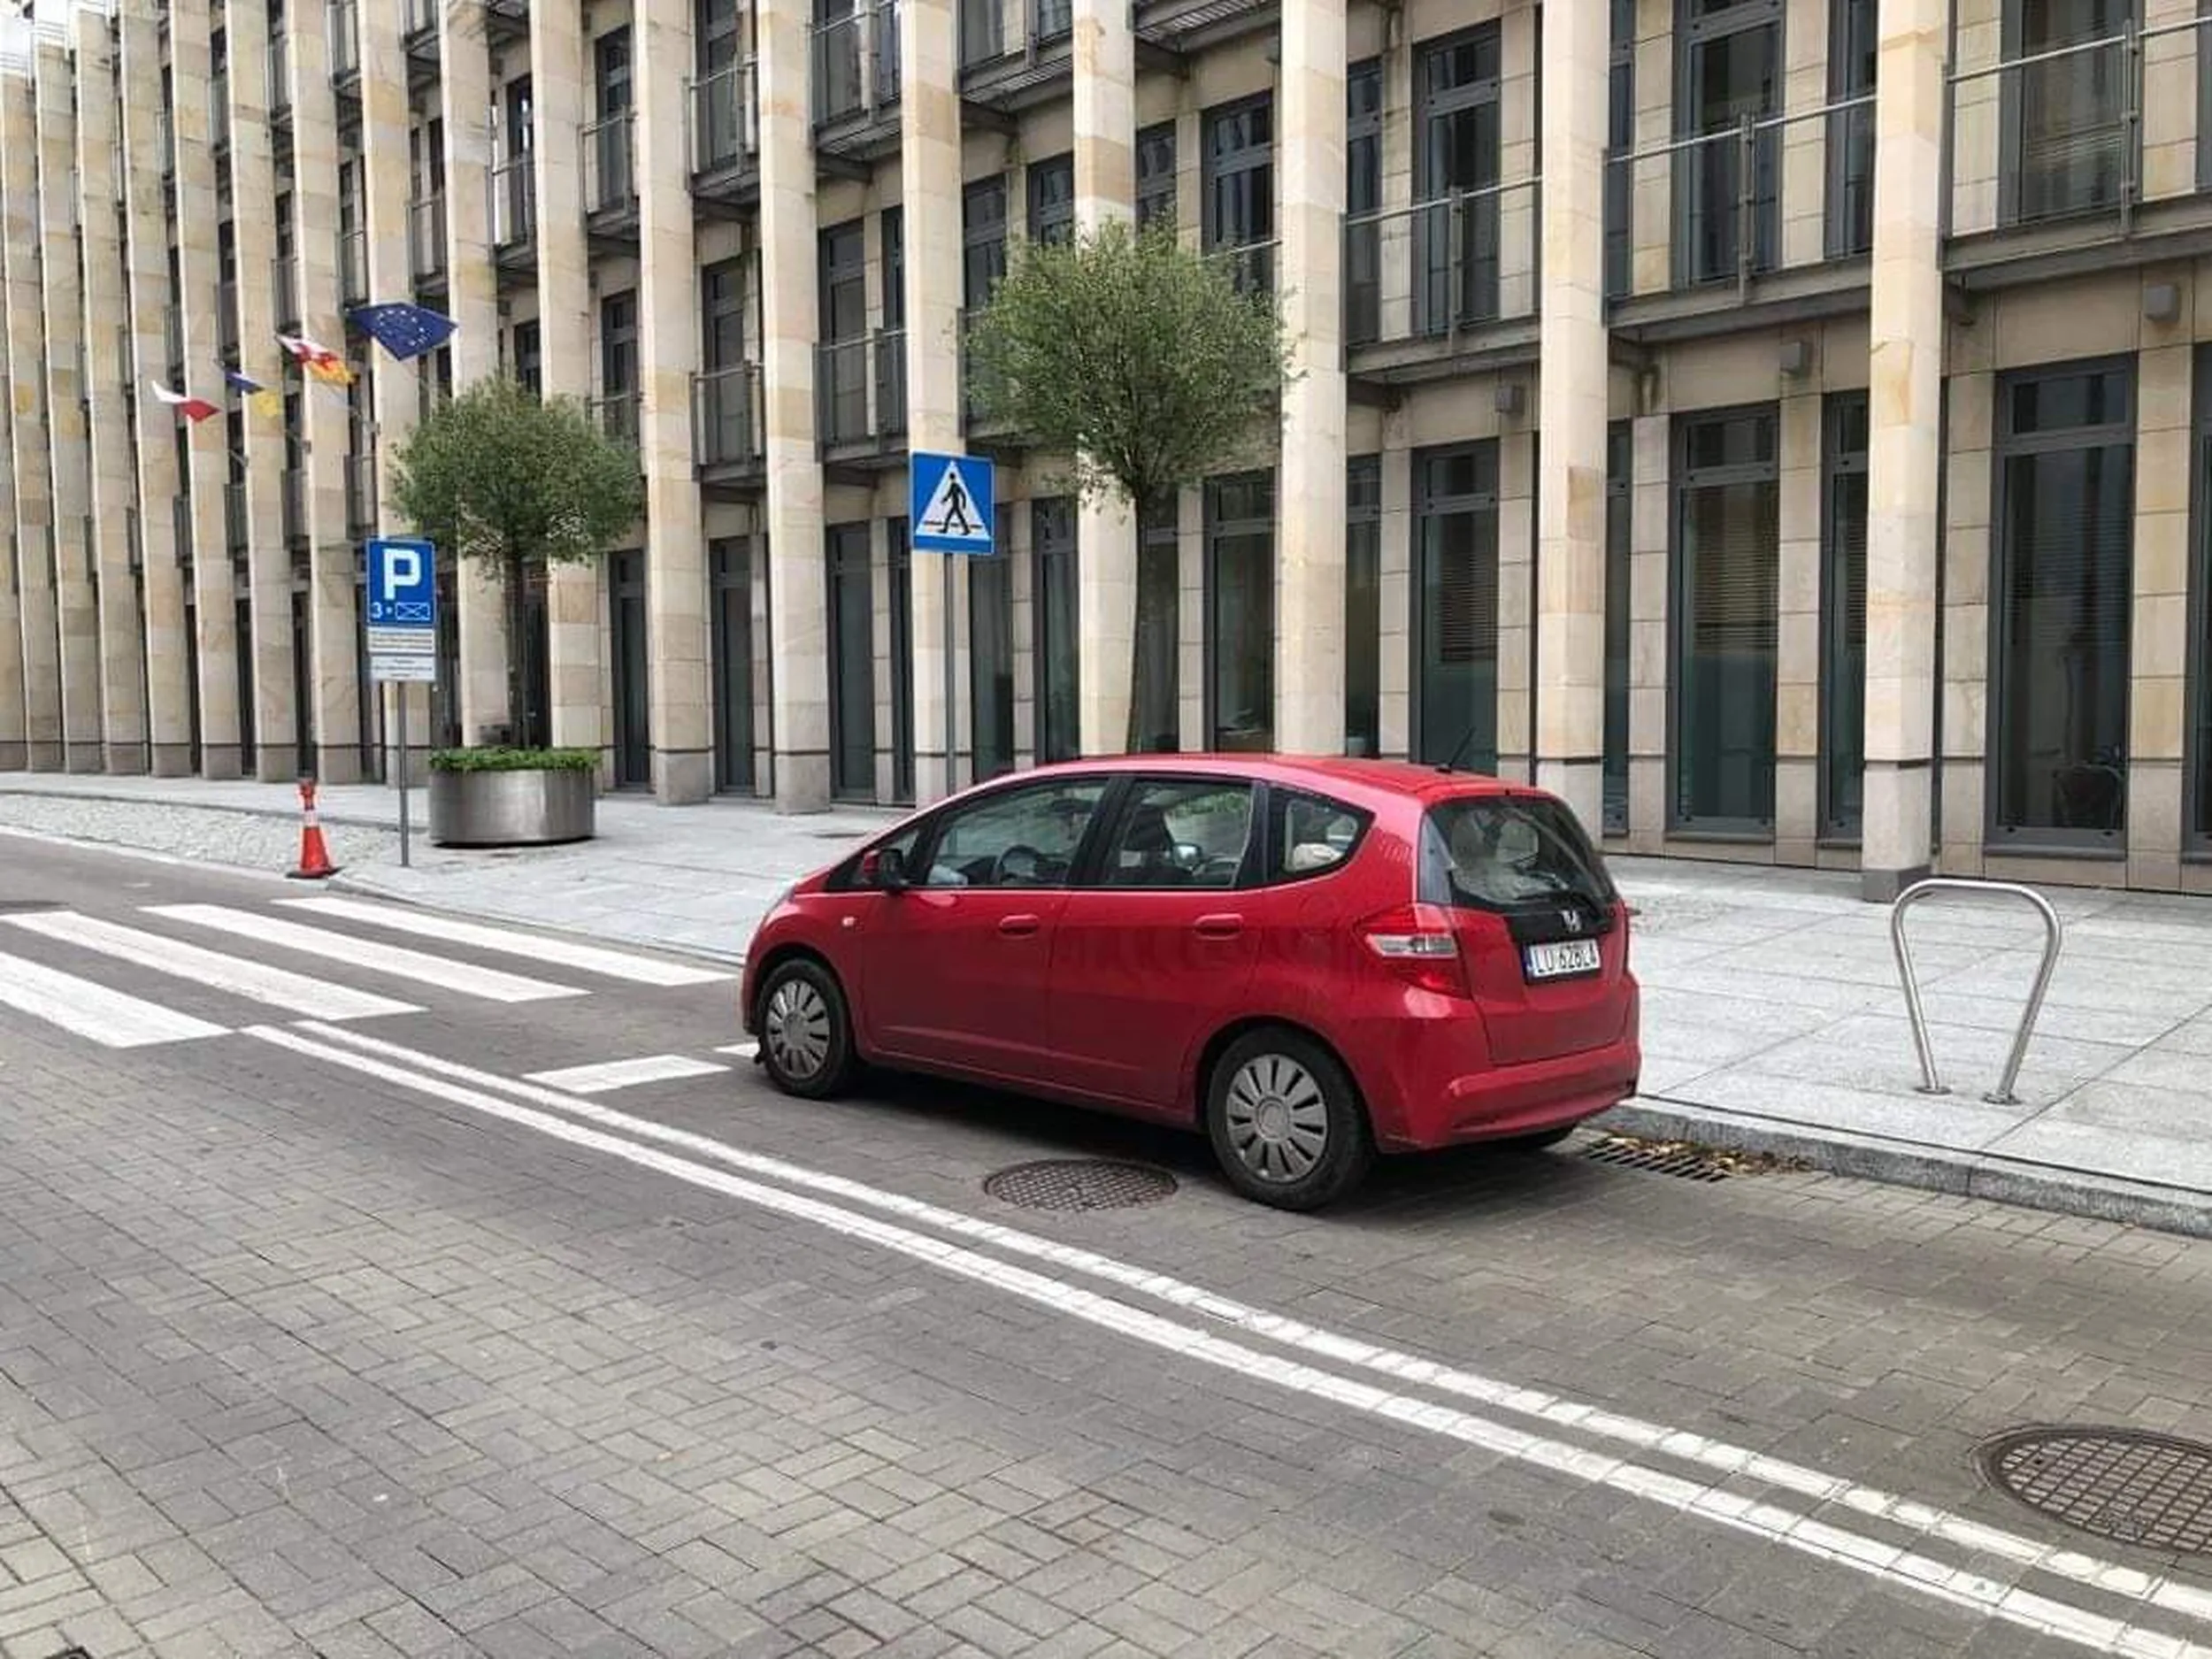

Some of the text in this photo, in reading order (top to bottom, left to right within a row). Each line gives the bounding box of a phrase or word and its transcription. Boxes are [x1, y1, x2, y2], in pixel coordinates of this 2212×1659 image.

[383, 548, 421, 600] P
[371, 602, 383, 619] 3
[1533, 948, 1555, 973] LU
